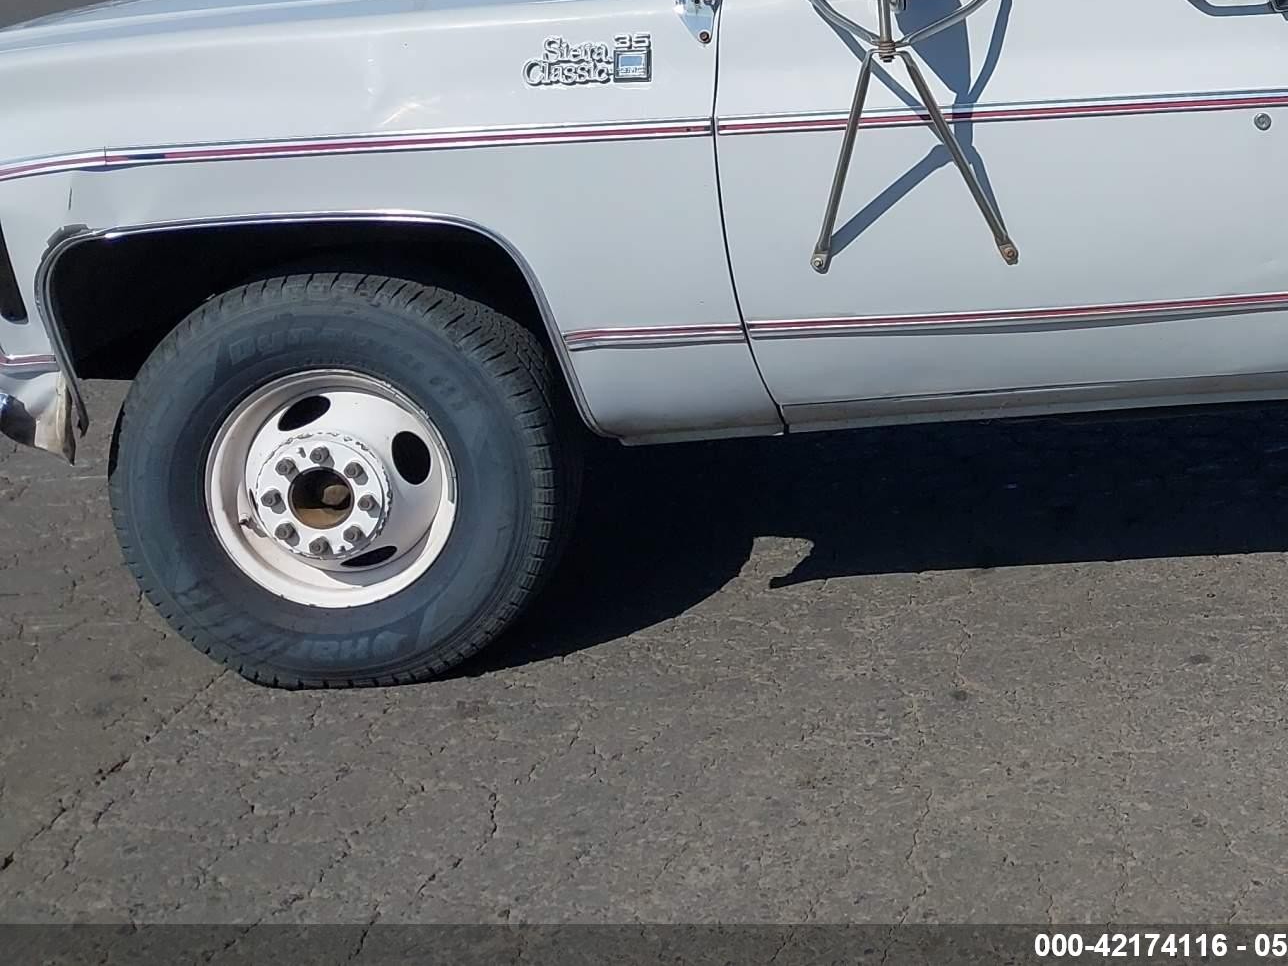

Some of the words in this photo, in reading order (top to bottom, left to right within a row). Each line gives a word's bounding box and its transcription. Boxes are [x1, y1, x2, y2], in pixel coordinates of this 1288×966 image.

[543, 35, 613, 63] Sierra
[614, 33, 651, 49] 35
[523, 58, 613, 85] Classic
